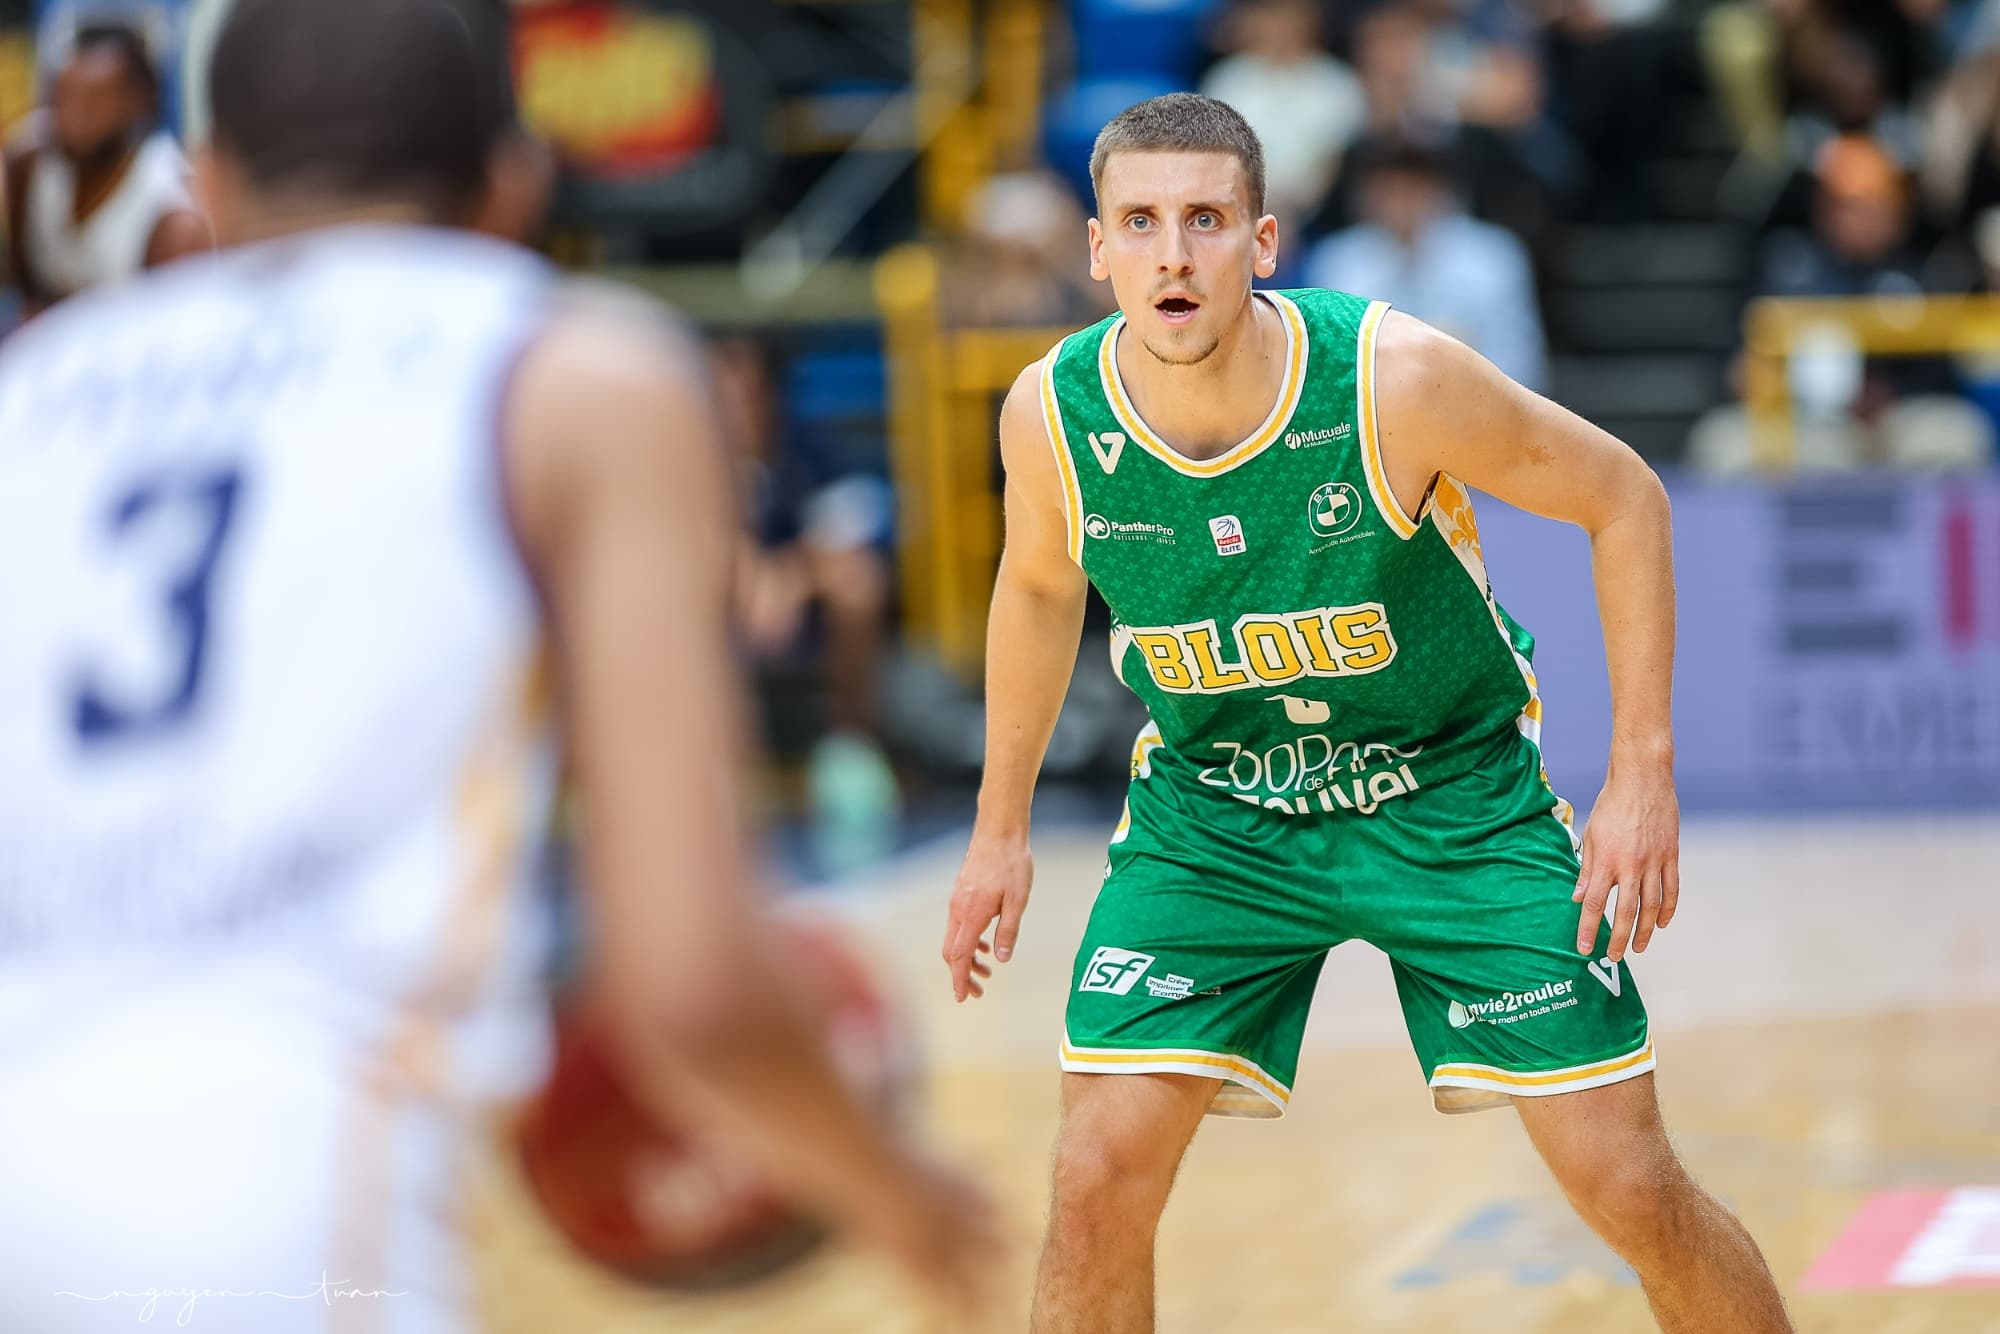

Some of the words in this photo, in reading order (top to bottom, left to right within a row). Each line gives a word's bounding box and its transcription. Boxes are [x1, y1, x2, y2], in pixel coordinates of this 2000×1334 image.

[1301, 422, 1351, 443] Mutuale
[1313, 486, 1349, 503] BMW
[75, 455, 244, 745] 3
[1126, 602, 1398, 694] BLOIS
[1305, 774, 1324, 790] de
[1082, 950, 1148, 988] isf
